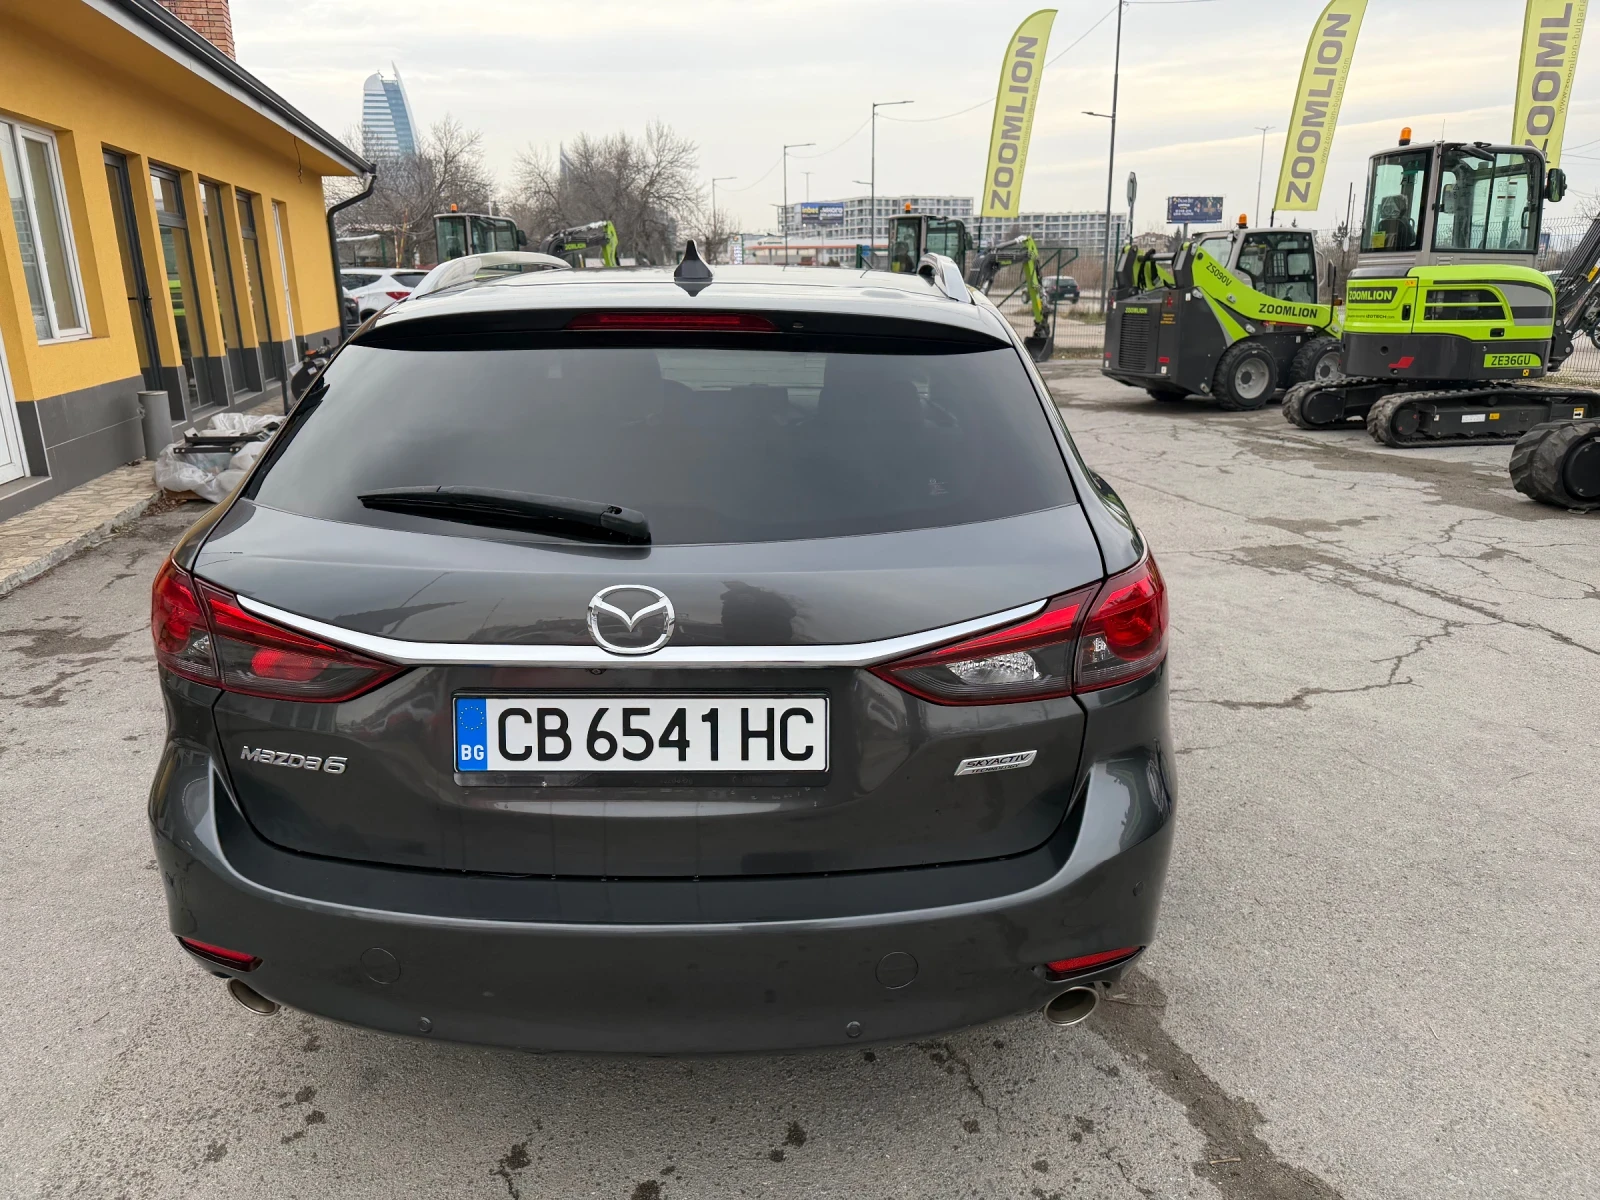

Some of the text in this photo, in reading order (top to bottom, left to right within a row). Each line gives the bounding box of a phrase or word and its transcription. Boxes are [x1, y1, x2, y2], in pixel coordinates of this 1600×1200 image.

[1285, 13, 1351, 203] ZOOMLION
[990, 35, 1038, 210] ZOOMLION
[1206, 261, 1232, 287] ZS090V
[1348, 290, 1393, 300] ZOOMLION
[1258, 303, 1318, 319] ZOOMLION
[1491, 355, 1531, 366] ZE36GU
[498, 707, 814, 762] CB 6541 HC
[461, 744, 485, 761] BG
[966, 753, 1030, 768] SKYACTIV
